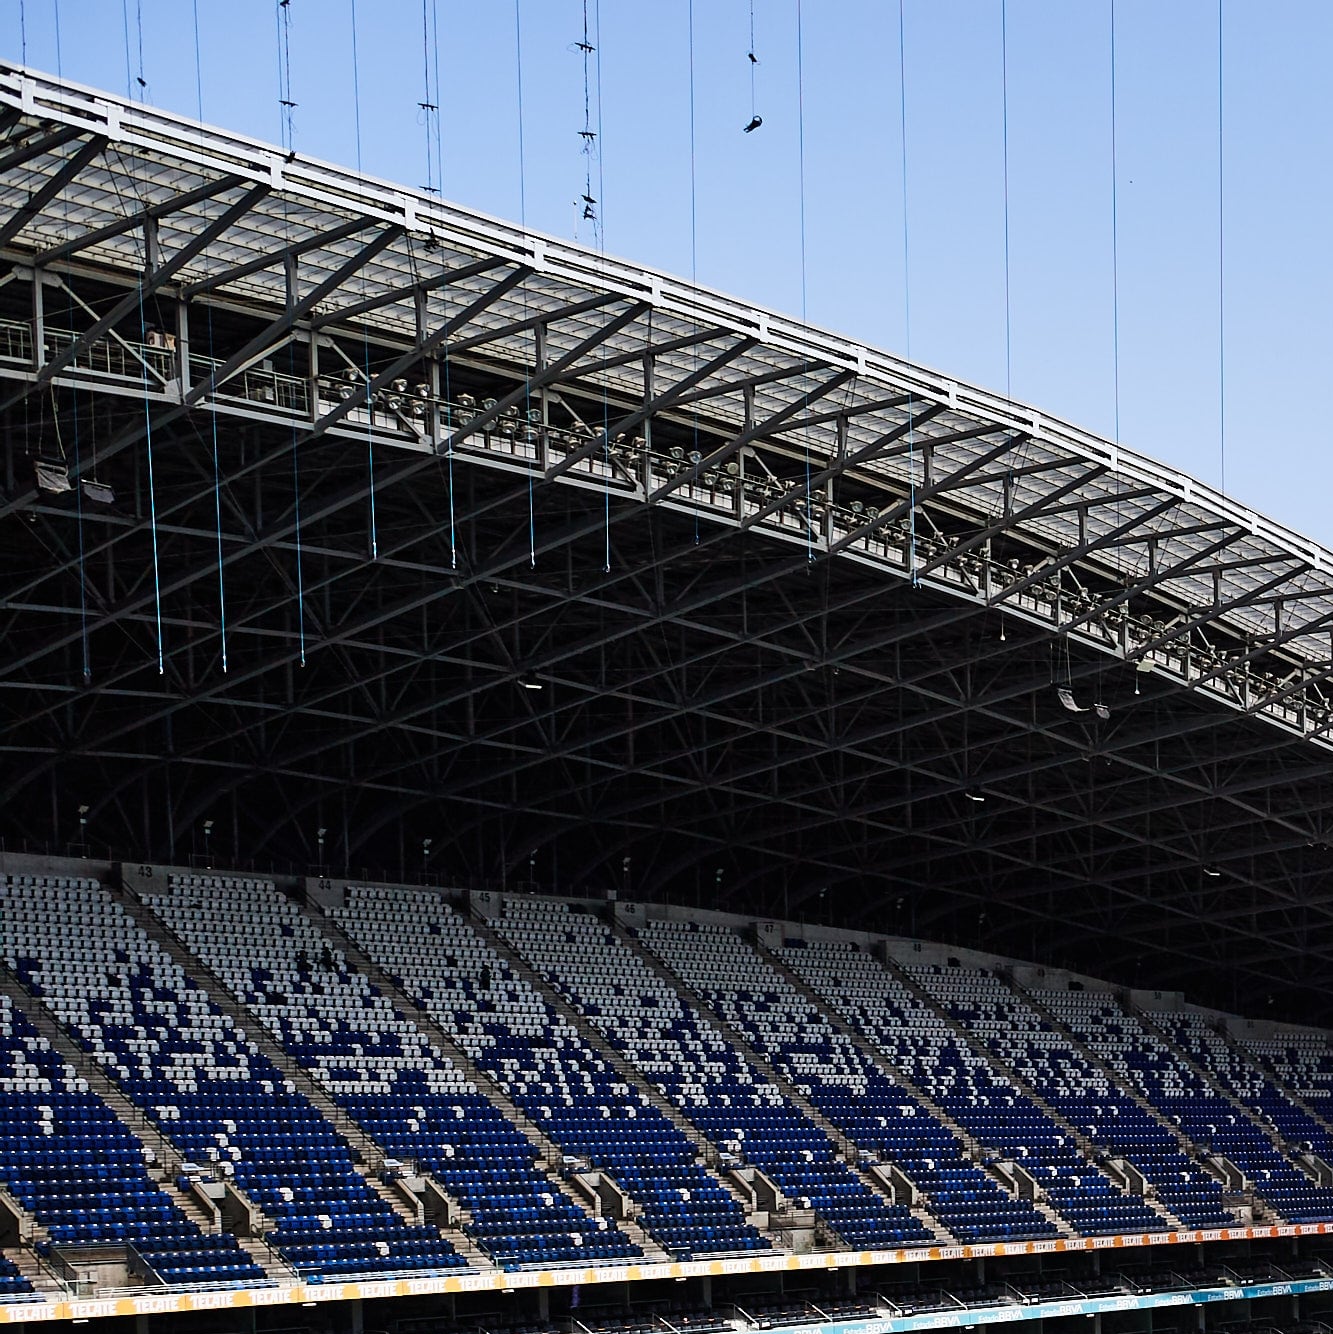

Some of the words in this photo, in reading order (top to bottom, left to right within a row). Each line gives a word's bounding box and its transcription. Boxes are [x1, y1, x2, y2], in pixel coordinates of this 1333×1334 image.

[138, 866, 152, 877] 43
[319, 880, 331, 890] 44
[479, 893, 490, 903] 45
[6, 1305, 55, 1320] TECATE
[70, 1301, 116, 1316] TECATE
[134, 1297, 178, 1312] TECATE
[190, 1294, 232, 1308] TECATE
[250, 1290, 290, 1304] TECATE
[304, 1287, 342, 1301] TECATE
[358, 1284, 396, 1297] TECATE
[408, 1280, 445, 1294] TECATE
[459, 1277, 495, 1290] TECATE
[502, 1275, 538, 1287] TECATE
[552, 1271, 586, 1284] TECATE
[594, 1269, 628, 1282] TECATE
[639, 1266, 671, 1279] TECATE
[679, 1264, 710, 1276] TECATE
[721, 1261, 751, 1273] TECATE
[760, 1259, 788, 1271] TECATE
[800, 1256, 827, 1268] TECATE
[834, 1254, 861, 1266] TECATE
[871, 1251, 897, 1263] TECATE
[904, 1249, 930, 1261] TECATE
[940, 1247, 964, 1258] TECATE
[865, 1321, 893, 1334] BBVA
[934, 1314, 960, 1327] BBVA
[998, 1310, 1022, 1321] BBVA
[1058, 1304, 1082, 1315] BBVA
[1116, 1298, 1138, 1309] BBVA
[1171, 1293, 1192, 1304] BBVA
